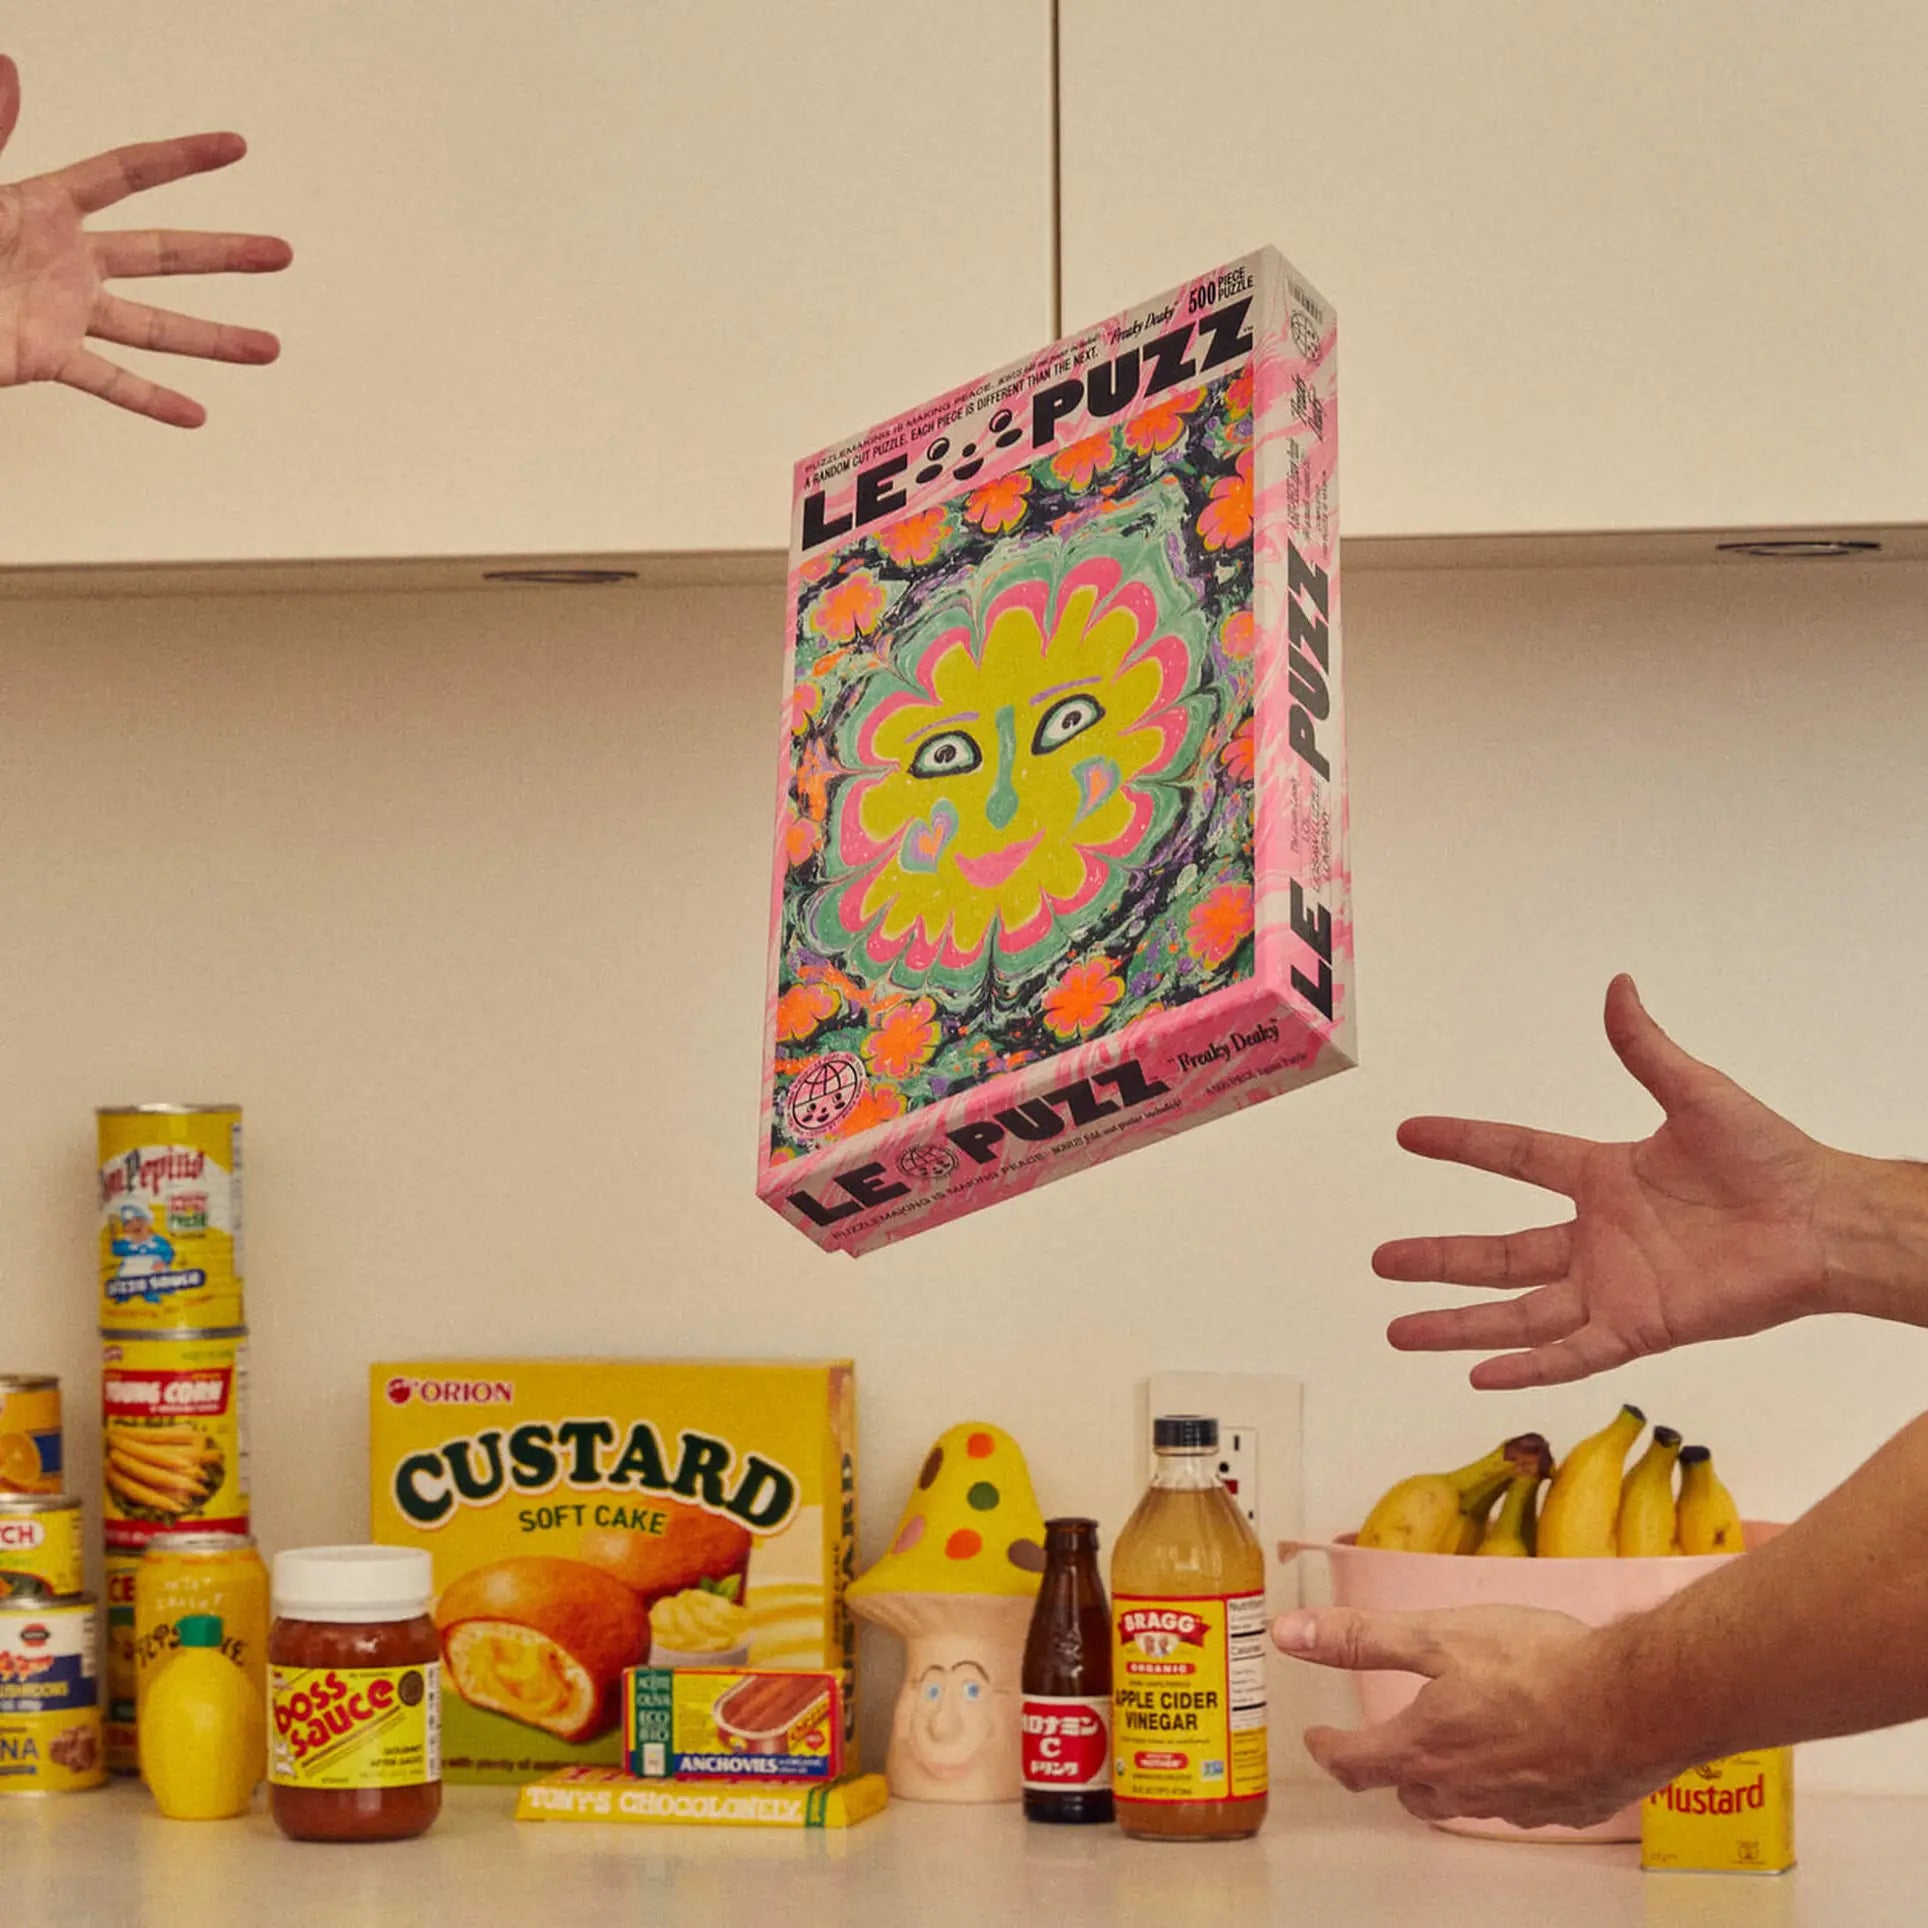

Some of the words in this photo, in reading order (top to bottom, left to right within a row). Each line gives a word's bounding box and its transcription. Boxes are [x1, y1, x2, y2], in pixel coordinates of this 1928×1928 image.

[1218, 266, 1246, 286] PIECE
[1218, 275, 1254, 302] PUZZLE
[1188, 282, 1216, 314] 500
[802, 447, 908, 551] LE
[1031, 296, 1254, 448] PUZZ
[803, 477, 812, 489] A
[812, 459, 850, 485] RANDOM
[852, 451, 872, 467] CUT
[872, 435, 909, 459] PUZZLE.
[911, 422, 935, 441] EACH
[937, 406, 965, 429] PIECE
[964, 402, 976, 416] IS
[976, 378, 1026, 411] DIFFERENT
[1027, 366, 1051, 389] THAN
[1053, 357, 1072, 377] THE
[1072, 345, 1100, 367] NEXT.
[804, 427, 891, 474] PUZZLEMAKING
[905, 403, 951, 427] MAKING
[1288, 537, 1330, 783] PUZZ
[1289, 876, 1333, 1022] LE
[786, 1162, 911, 1227] LE
[945, 1059, 1171, 1165] PUZZ
[832, 1197, 931, 1240] PUZZLEMAKING
[932, 1191, 946, 1201] IS
[420, 1381, 513, 1402] ORION
[394, 1421, 795, 1528] CUSTARD
[519, 1504, 586, 1533] SOFT
[594, 1504, 667, 1535] CAKE
[1124, 1611, 1196, 1634] BRAGG
[1130, 1663, 1188, 1674] ORGANIC
[1115, 1687, 1155, 1710] APPLE
[1160, 1690, 1219, 1710] CIDER
[1125, 1711, 1198, 1731] VINEGAR
[1040, 1737, 1062, 1759] C
[680, 1756, 779, 1774] ANCHOVIES
